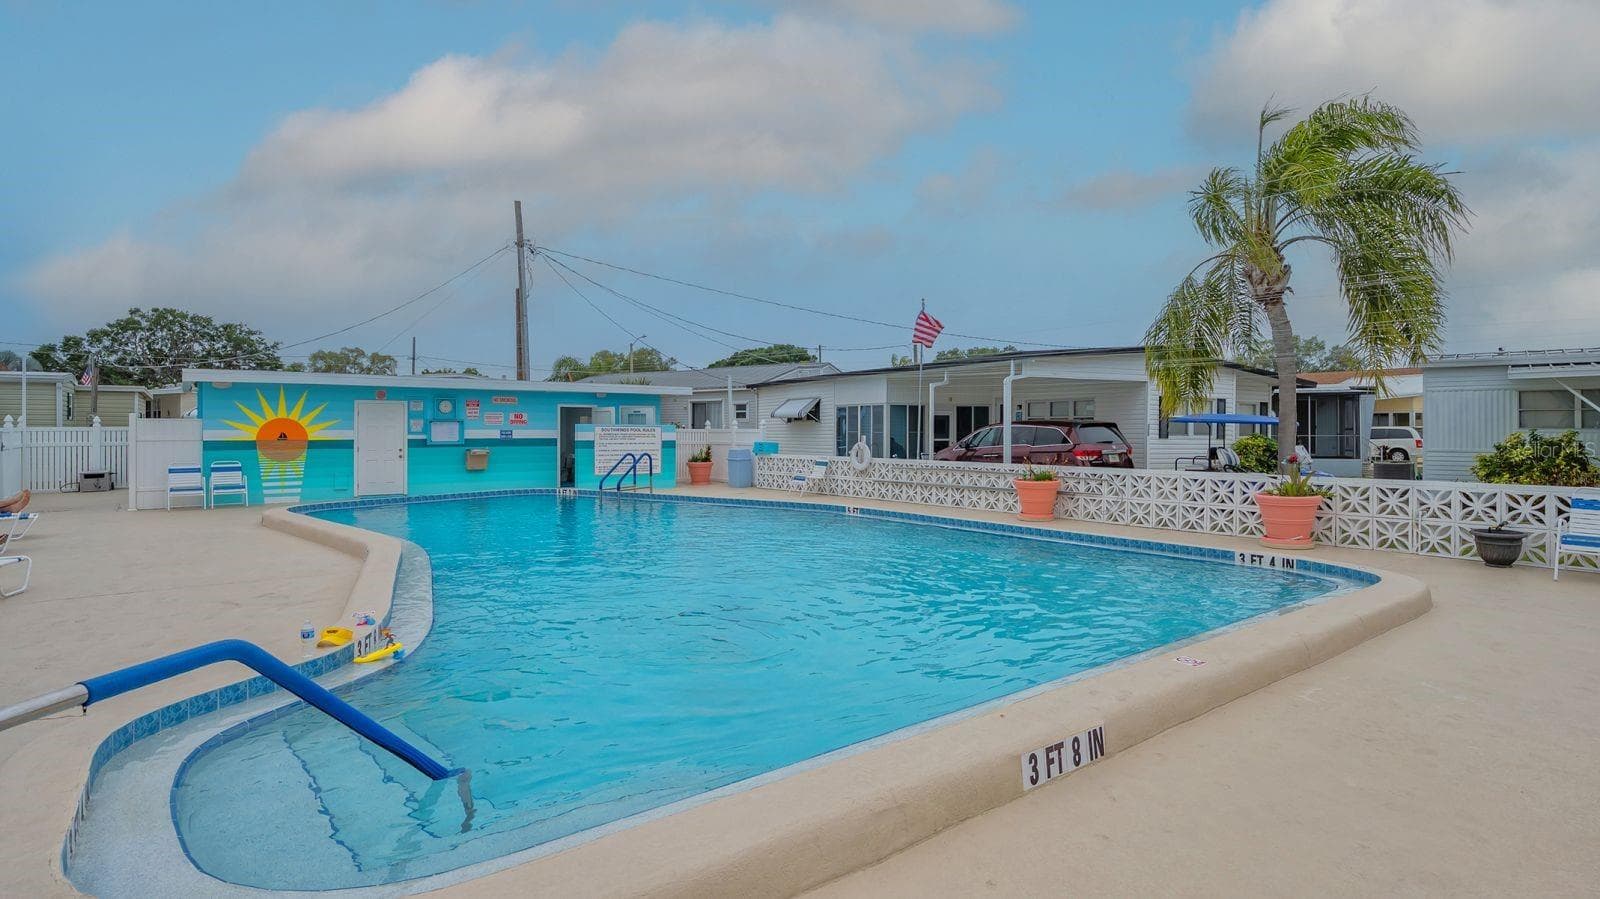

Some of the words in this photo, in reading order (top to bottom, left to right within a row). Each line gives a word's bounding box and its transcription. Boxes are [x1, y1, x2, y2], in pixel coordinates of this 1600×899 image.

[1239, 553, 1246, 563] 3
[1250, 554, 1264, 566] FT
[1269, 556, 1276, 567] 4
[1282, 557, 1295, 569] IN
[1028, 752, 1040, 786] 3
[1045, 741, 1065, 779] FT
[1071, 735, 1082, 767] 8
[1087, 726, 1105, 761] IN
